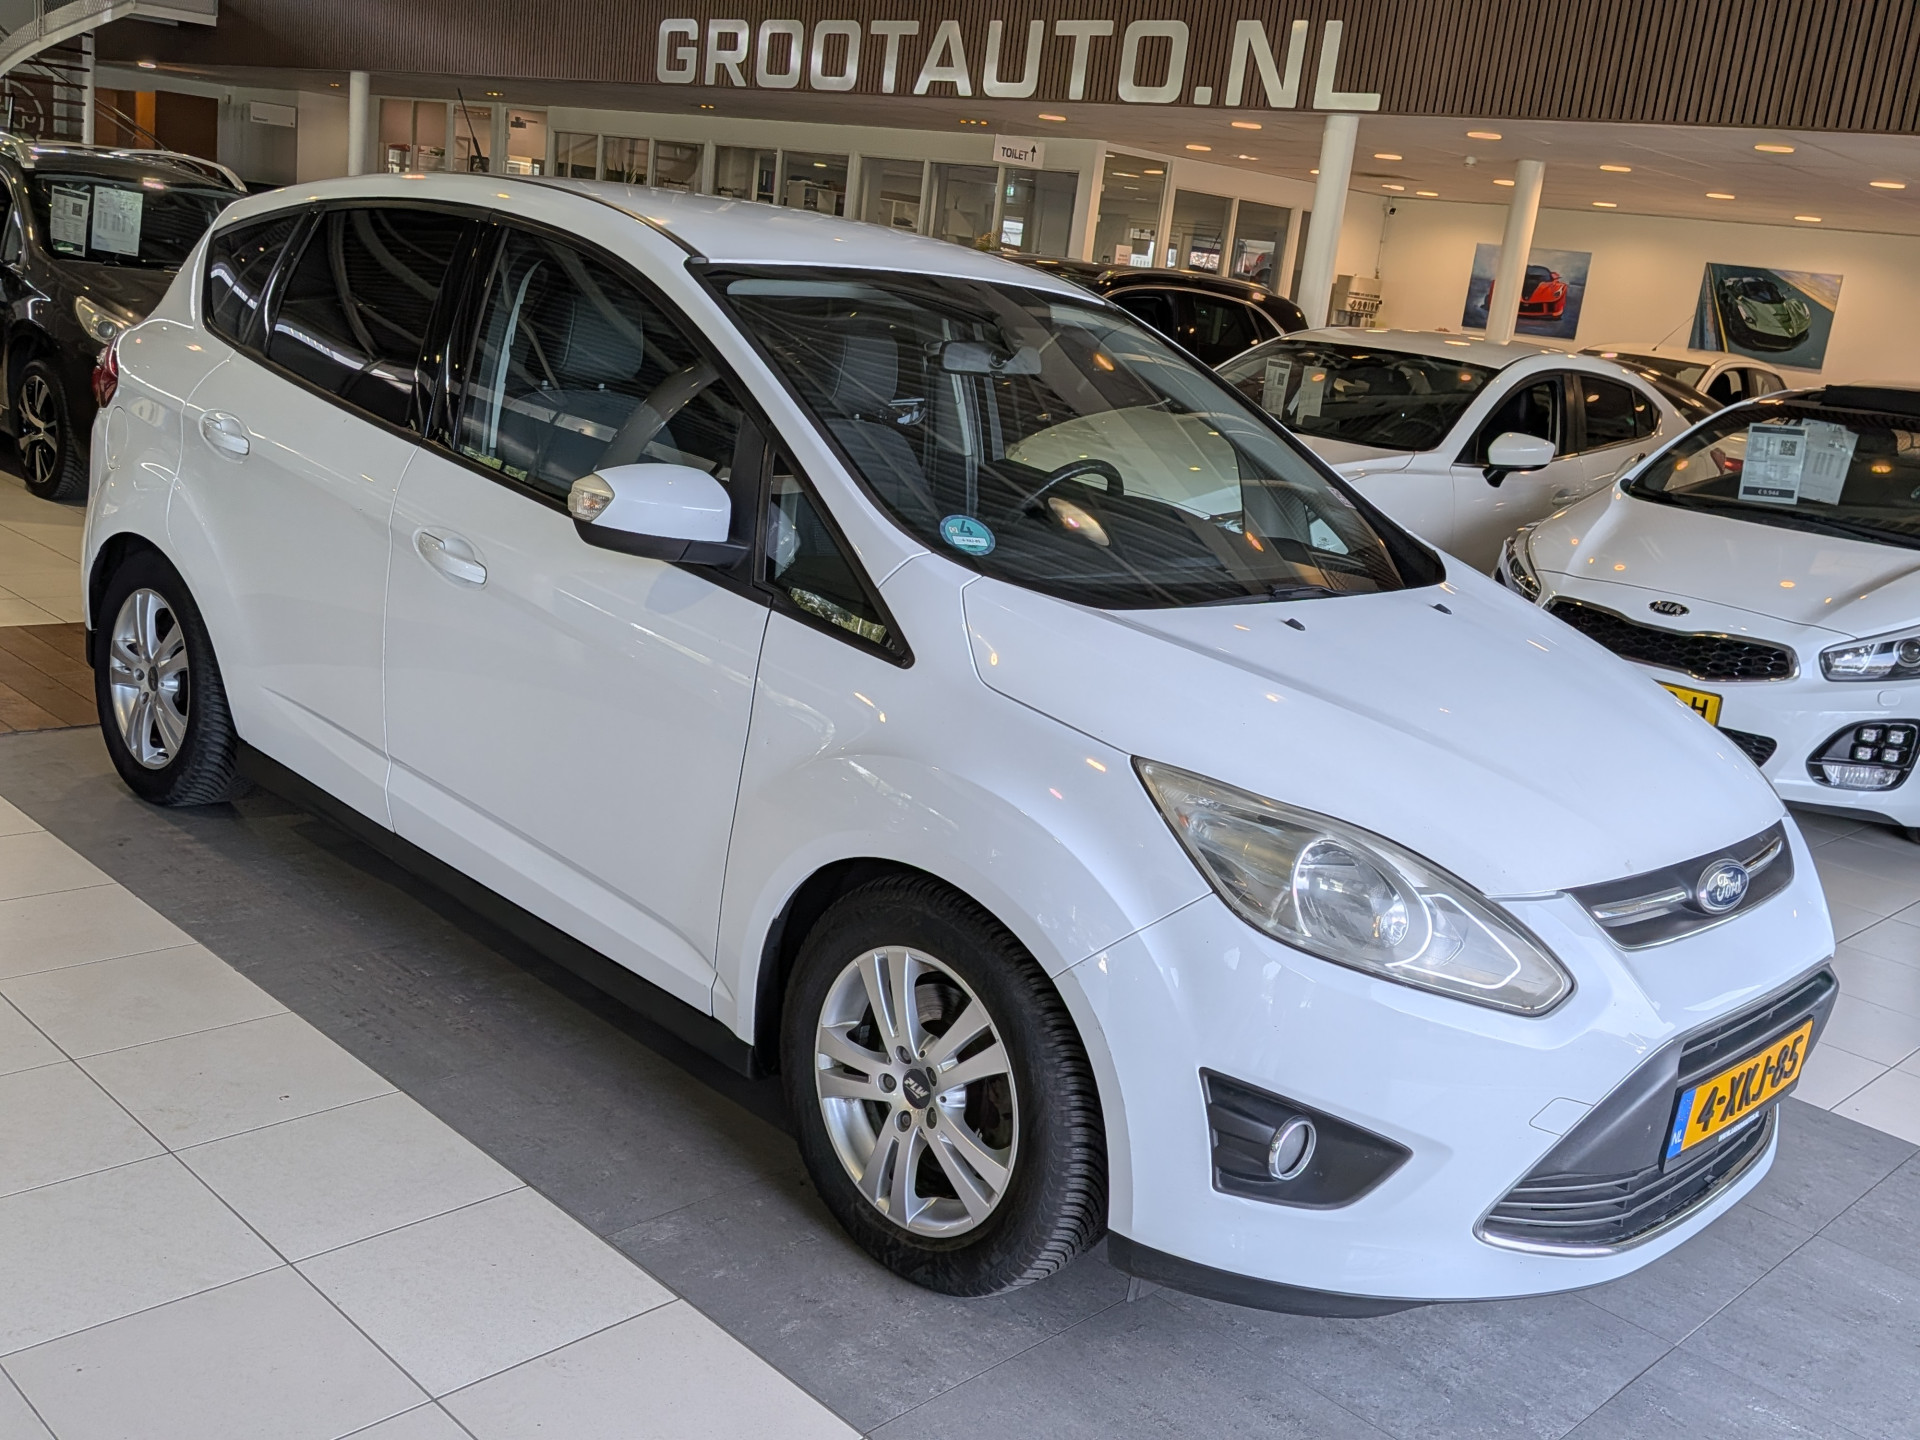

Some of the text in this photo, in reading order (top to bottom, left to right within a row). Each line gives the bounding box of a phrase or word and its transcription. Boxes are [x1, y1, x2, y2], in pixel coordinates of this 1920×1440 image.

[656, 18, 1381, 111] GROOTAUTO.NL
[1001, 146, 1029, 161] TOILET
[960, 520, 974, 536] 4
[1653, 601, 1683, 614] KIA
[1716, 871, 1742, 902] Ford
[1696, 1034, 1804, 1132] 4-XKJ-85
[1671, 1129, 1683, 1146] NL
